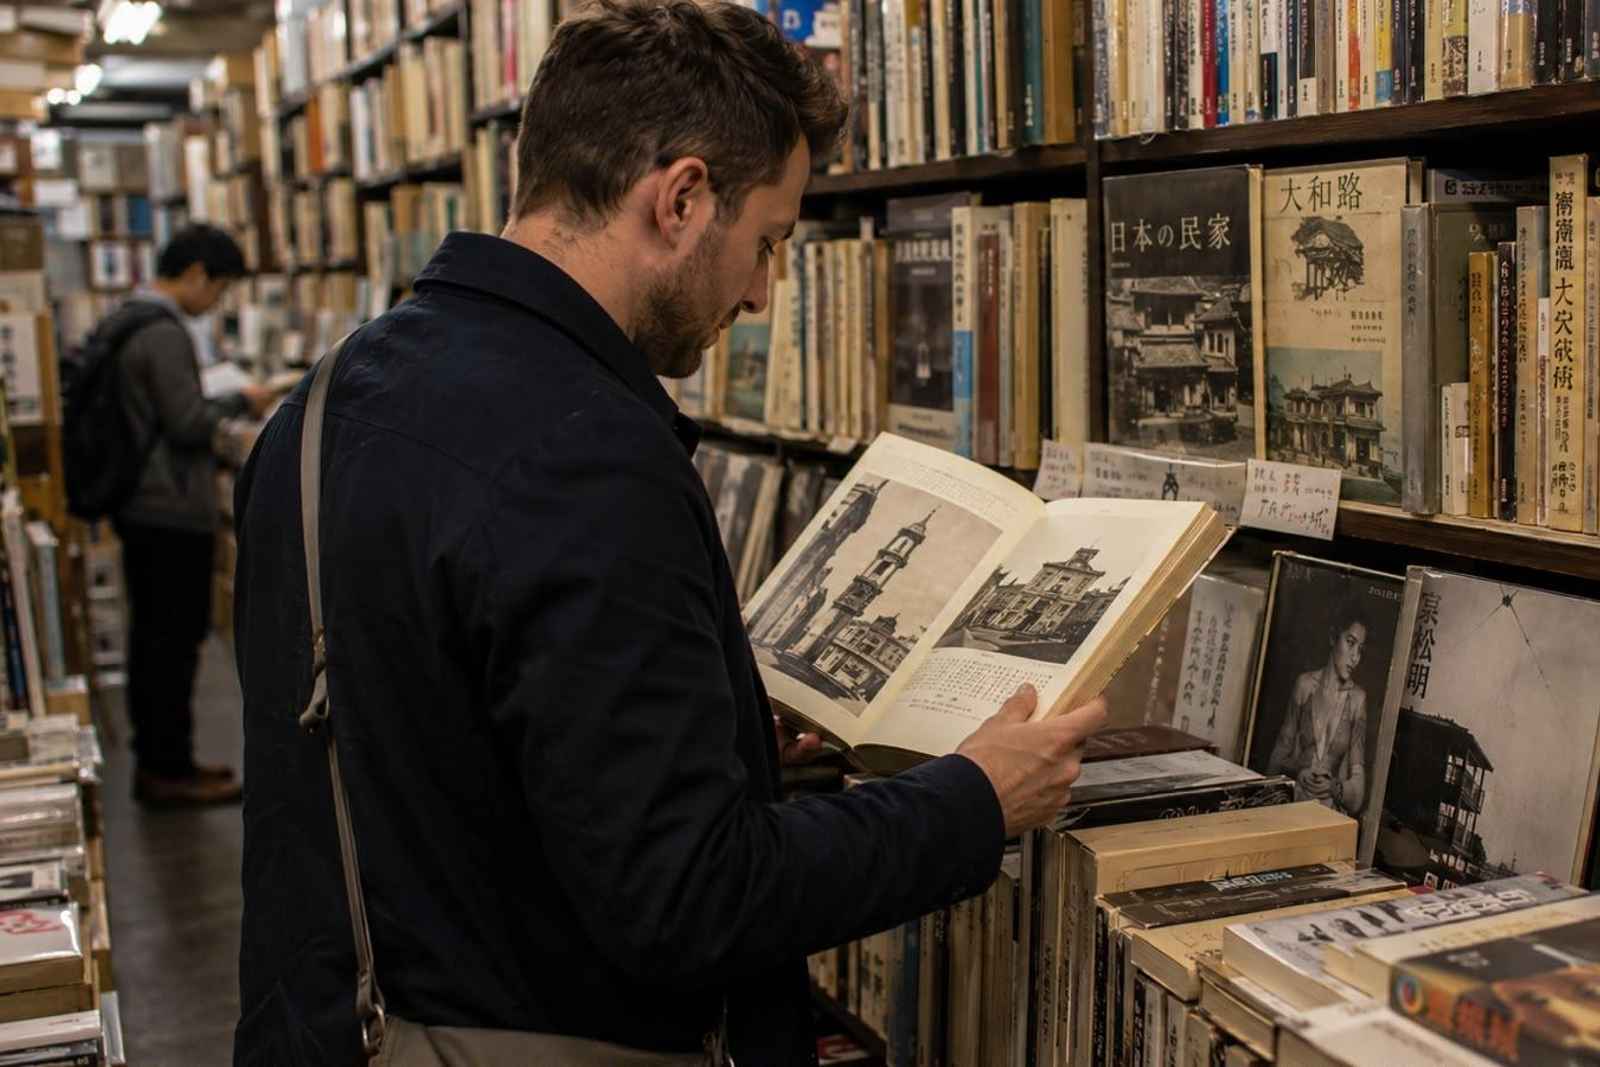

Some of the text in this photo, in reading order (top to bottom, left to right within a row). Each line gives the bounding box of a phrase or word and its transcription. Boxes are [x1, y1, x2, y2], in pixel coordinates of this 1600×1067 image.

[1280, 172, 1363, 213] 大和路
[1111, 213, 1232, 253] 日本の民家
